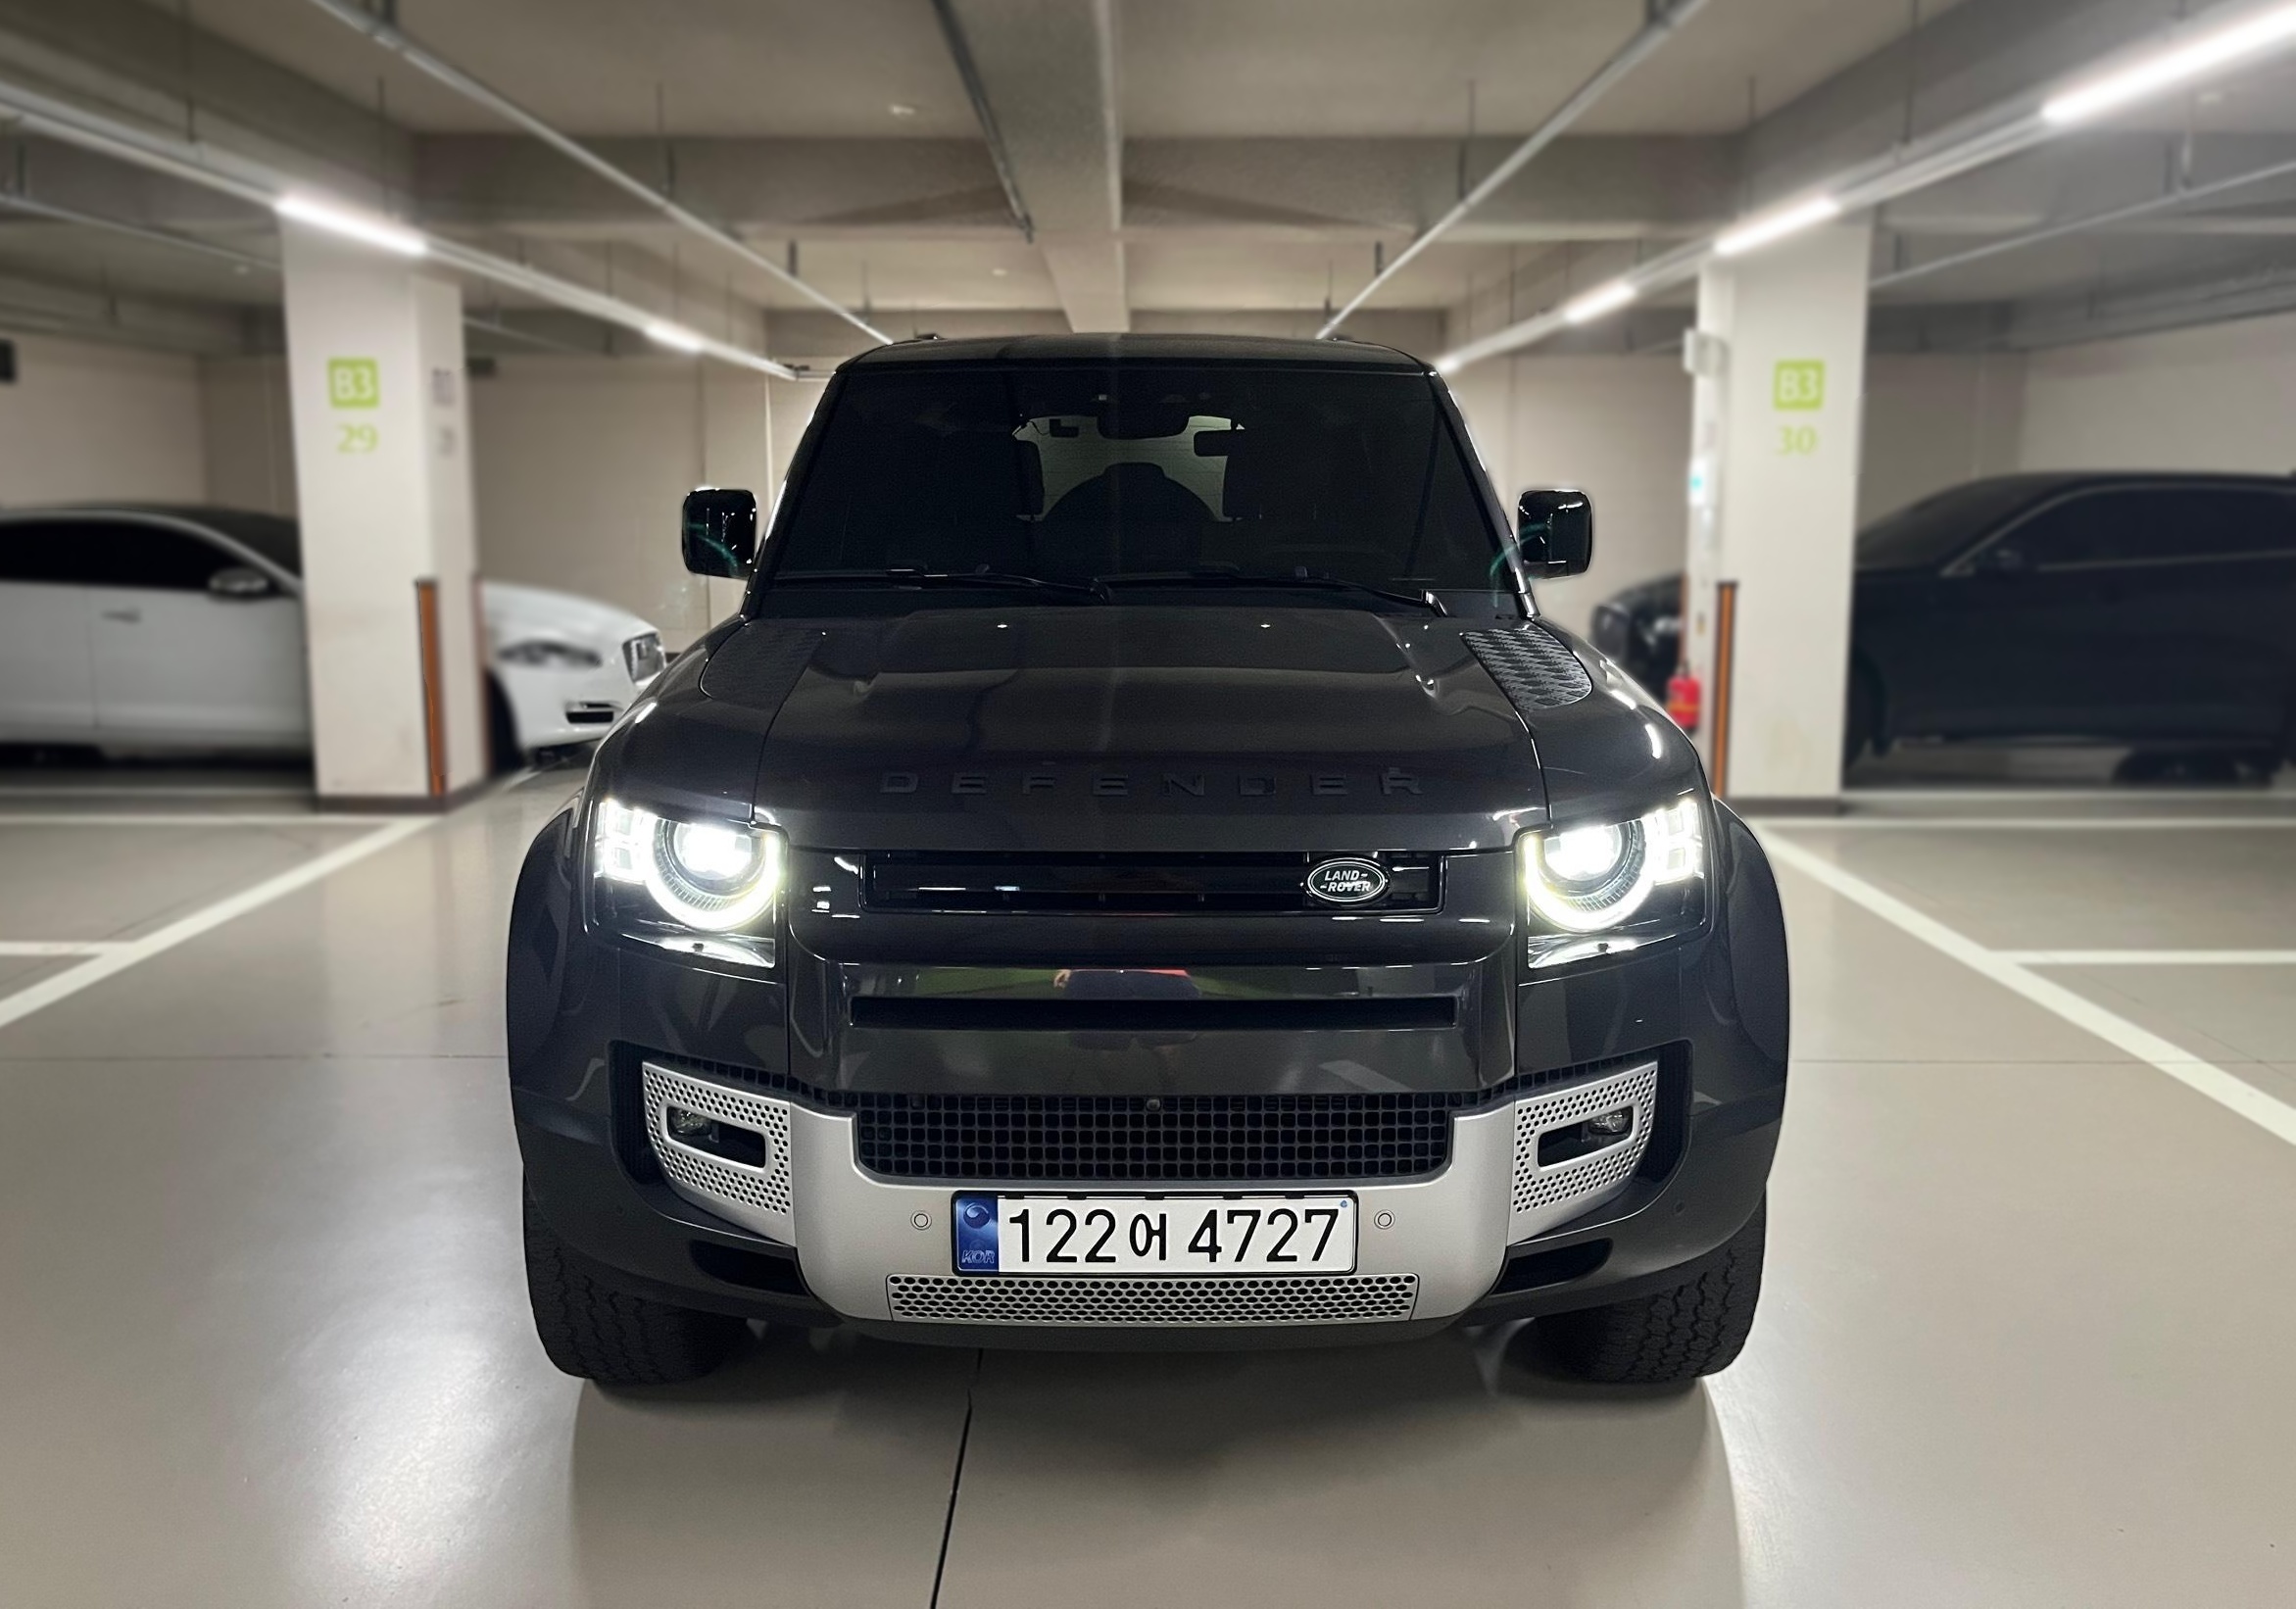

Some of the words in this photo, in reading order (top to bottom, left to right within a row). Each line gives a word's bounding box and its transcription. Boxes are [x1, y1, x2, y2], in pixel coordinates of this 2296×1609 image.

[333, 366, 374, 401] B3
[1778, 367, 1819, 402] B3
[336, 422, 379, 455] 29
[1776, 424, 1819, 456] 30
[879, 769, 1424, 797] DEFENDER
[1008, 1208, 1167, 1263] 122어
[1188, 1208, 1340, 1263] 4727
[961, 1249, 996, 1264] KOR
